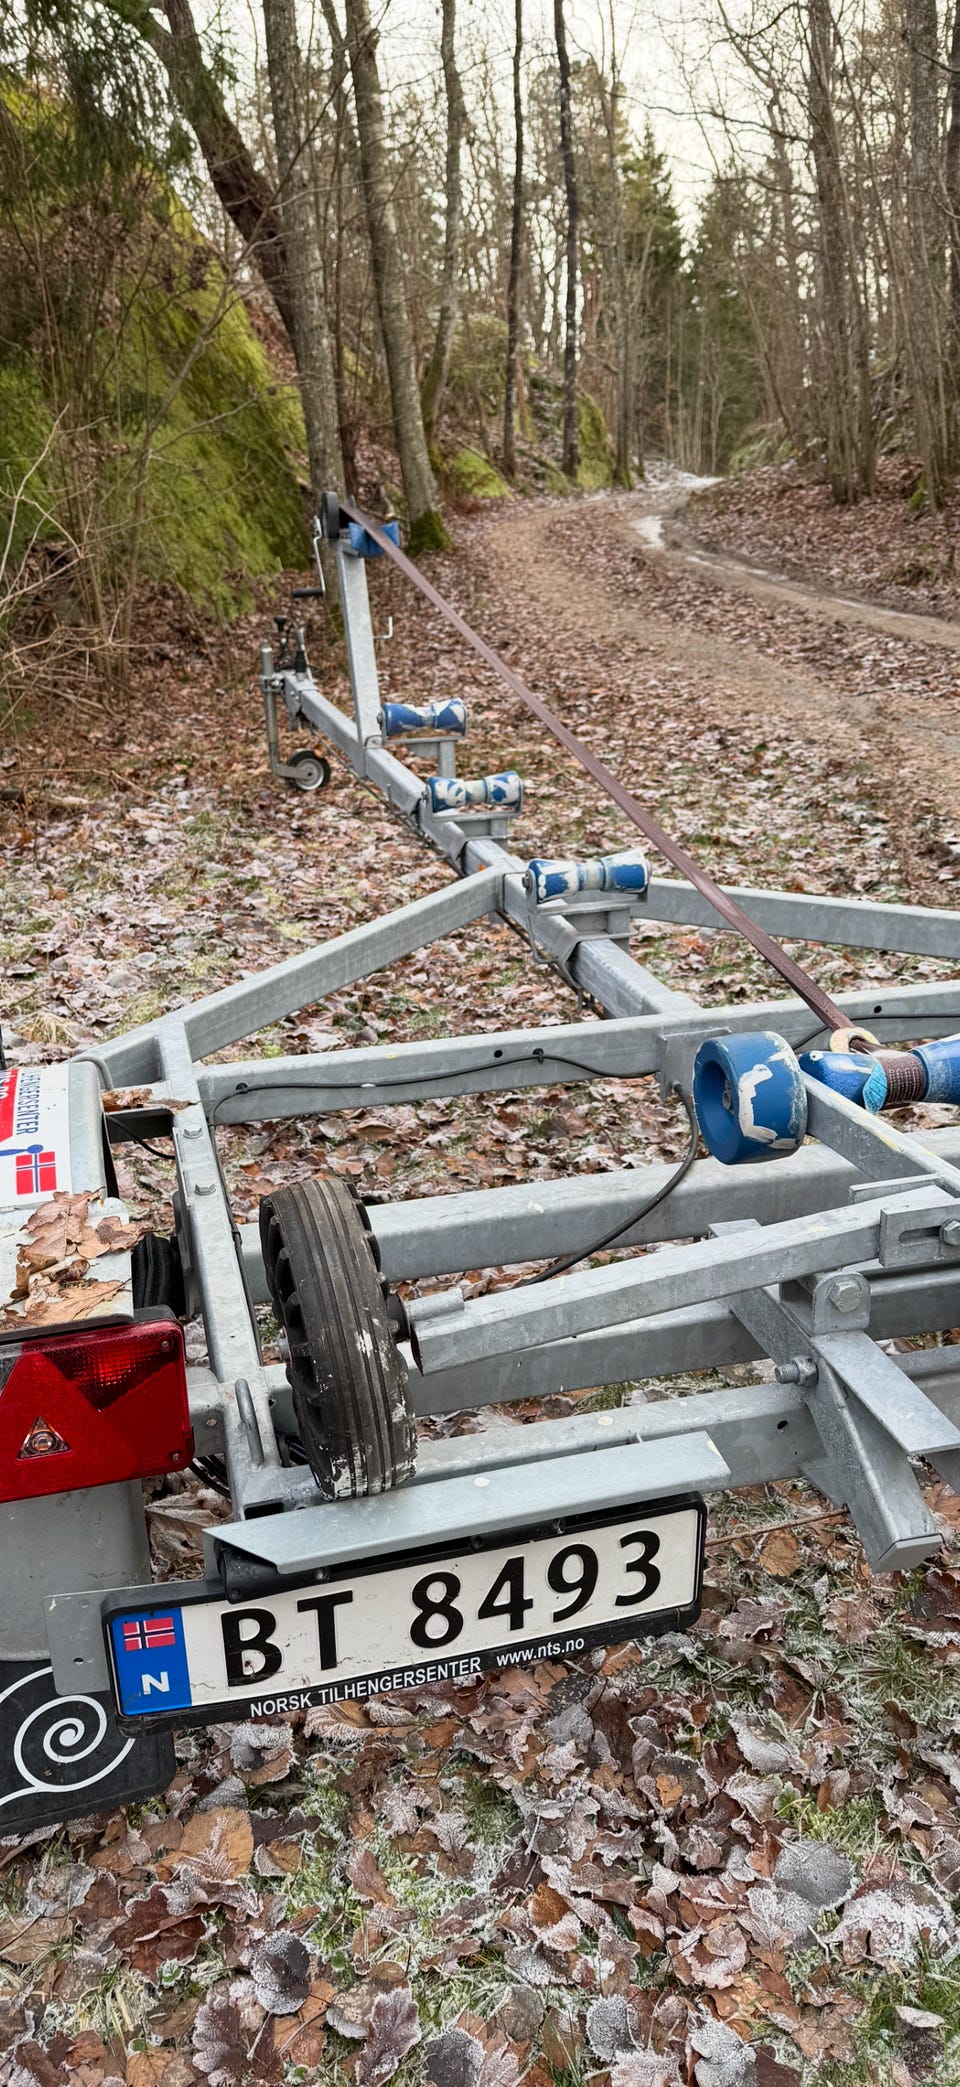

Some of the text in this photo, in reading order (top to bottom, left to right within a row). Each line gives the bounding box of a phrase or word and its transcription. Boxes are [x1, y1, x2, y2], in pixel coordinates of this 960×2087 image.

[220, 1530, 662, 1688] BT 8493
[141, 1671, 170, 1695] N
[250, 1637, 585, 1718] NORSK TILHENGERSENTER www.nts.no
